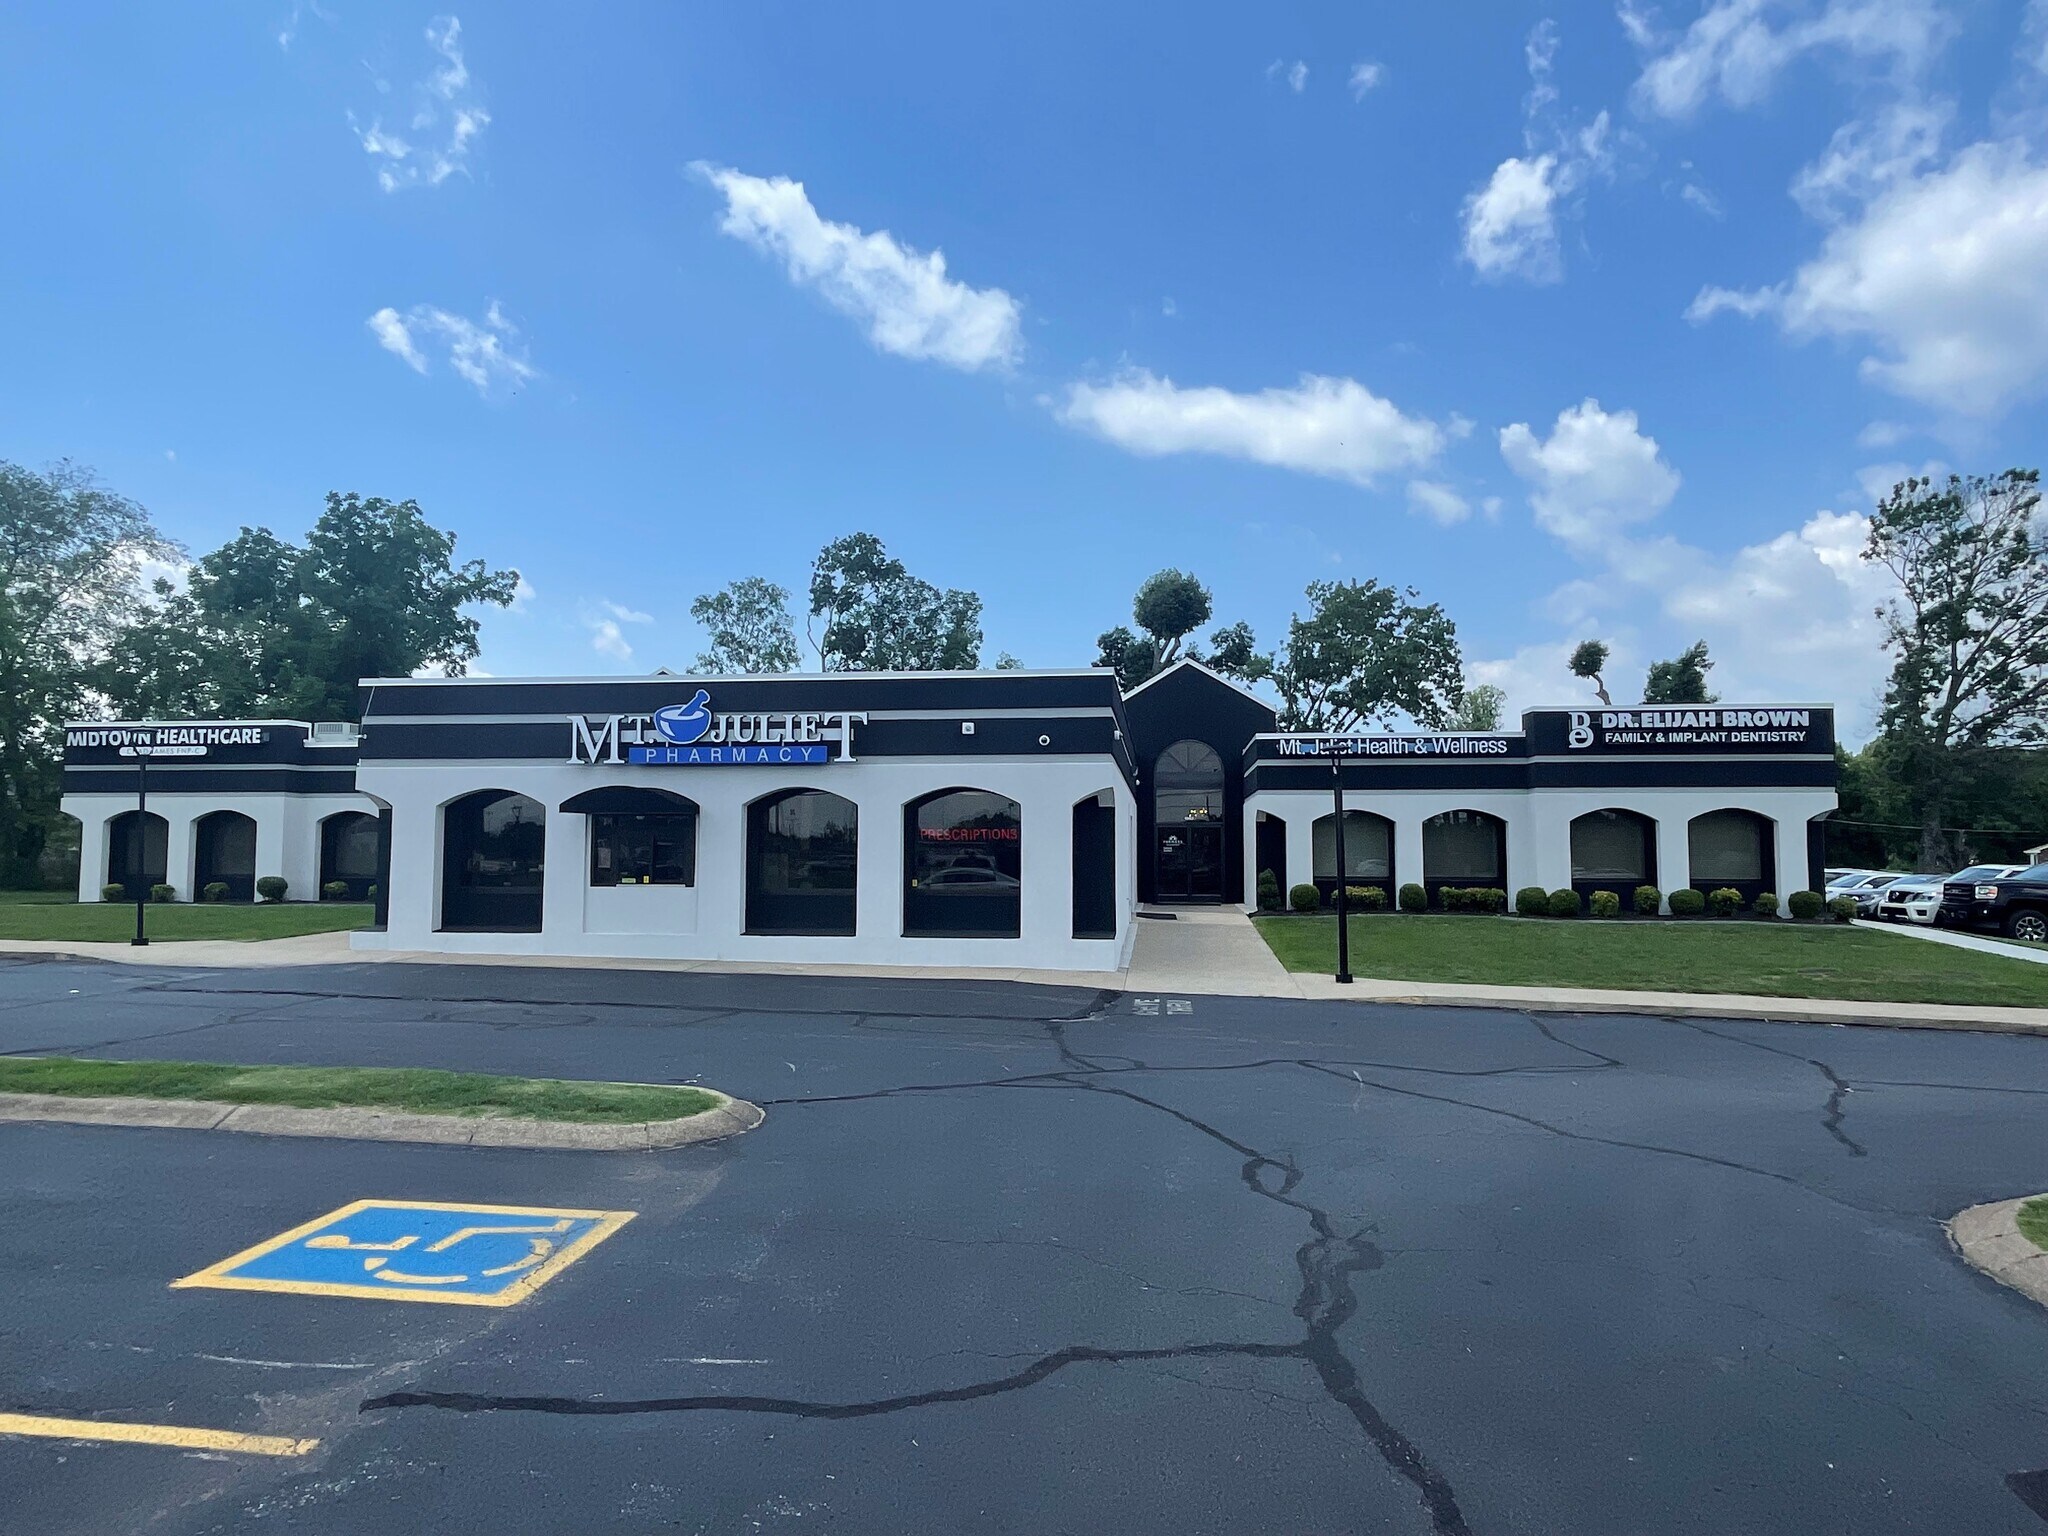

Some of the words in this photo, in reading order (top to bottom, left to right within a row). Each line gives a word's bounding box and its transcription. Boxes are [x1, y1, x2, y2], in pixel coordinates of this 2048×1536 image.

[1602, 713, 1639, 728] DR.
[1641, 712, 1716, 728] ELIJAH
[1722, 711, 1809, 727] BROWN
[156, 728, 262, 744] HEALTHCARE
[566, 714, 655, 764] MT.
[709, 712, 868, 762] JULIET
[1605, 732, 1652, 743] FAMILY
[1655, 732, 1664, 743] &
[1669, 732, 1727, 742] IMPLANT
[1731, 731, 1806, 742] DENTISTRY
[1279, 739, 1306, 755] Mt.
[1357, 738, 1408, 754] Health
[1414, 738, 1428, 754] &
[1432, 737, 1507, 753] Wellness
[645, 747, 813, 763] PHARMACY
[921, 828, 1018, 840] PRESCRIPTIONS
